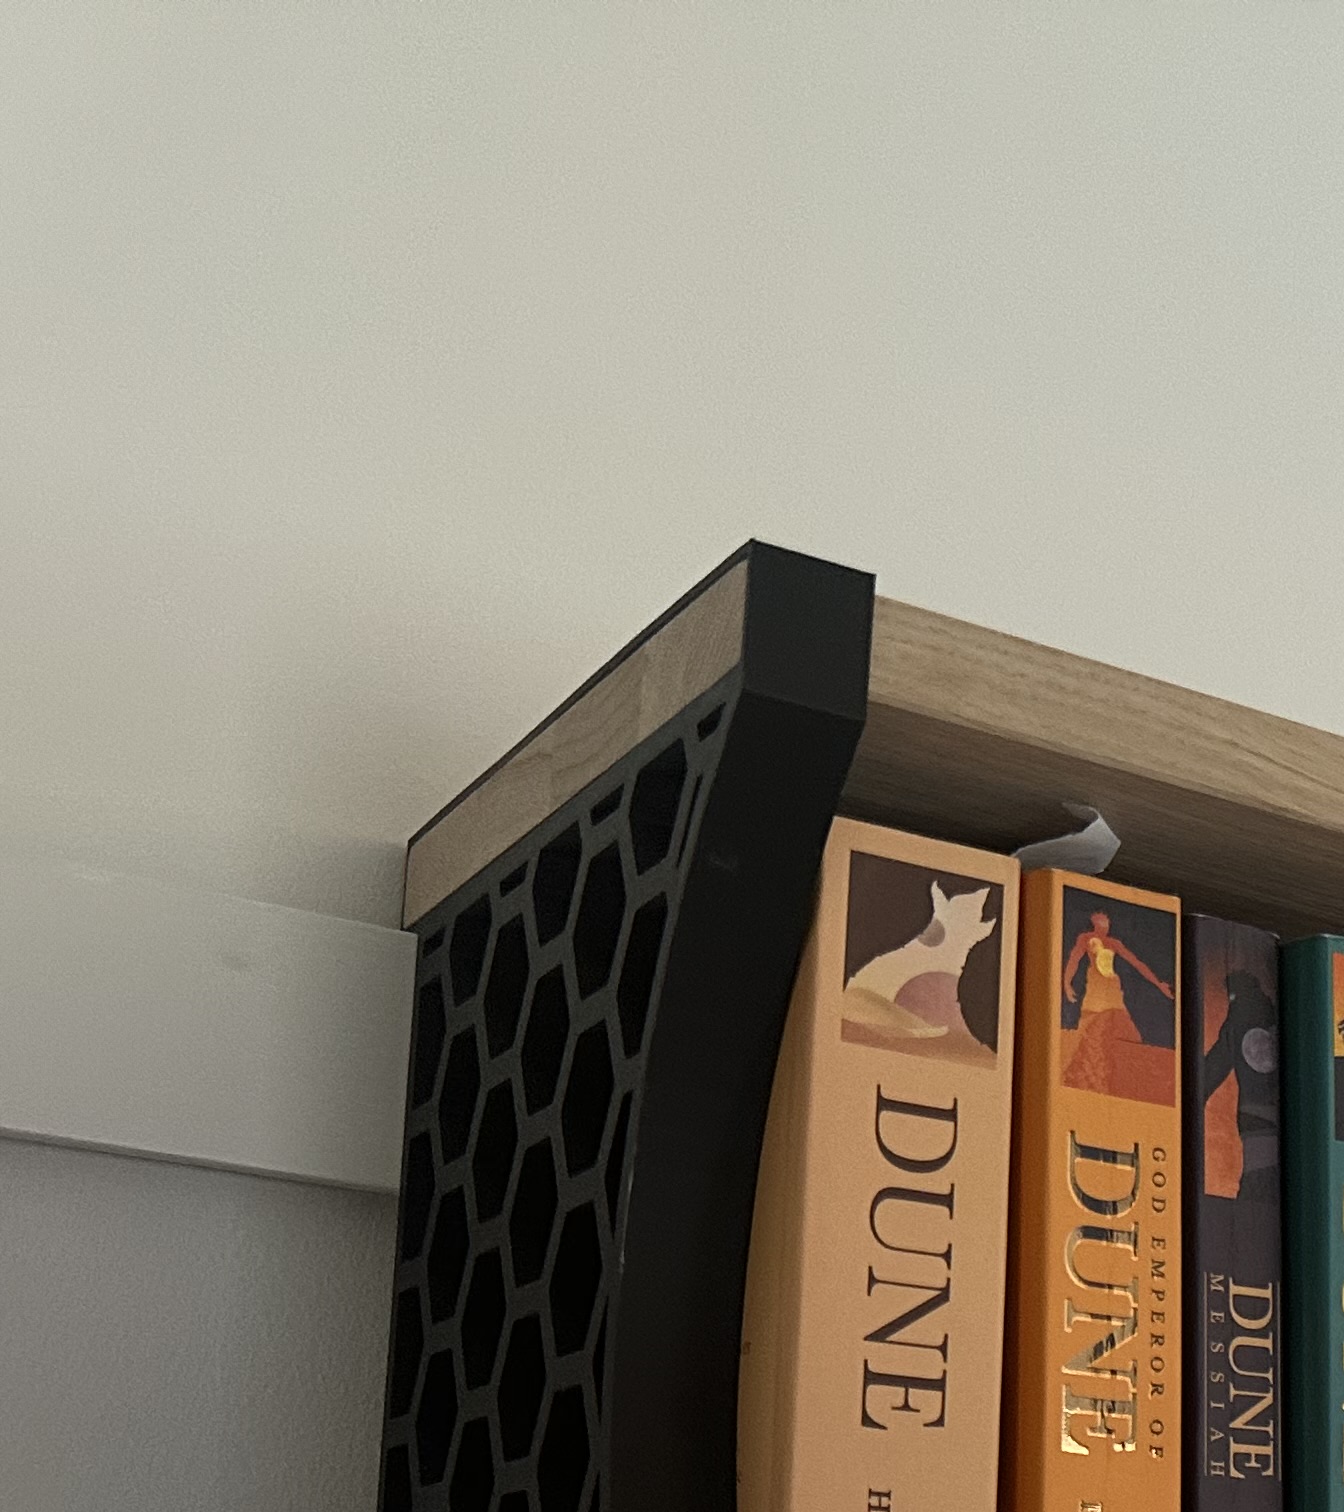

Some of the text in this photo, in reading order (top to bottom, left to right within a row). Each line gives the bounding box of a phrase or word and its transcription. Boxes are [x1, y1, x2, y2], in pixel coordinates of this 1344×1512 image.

[860, 1083, 958, 1430] DUNE
[1060, 1130, 1141, 1455] DUNE
[1148, 1146, 1166, 1459] GOD EMPEROR OF
[1208, 1272, 1225, 1477] MESSIAH
[1228, 1281, 1274, 1479] DUNE
